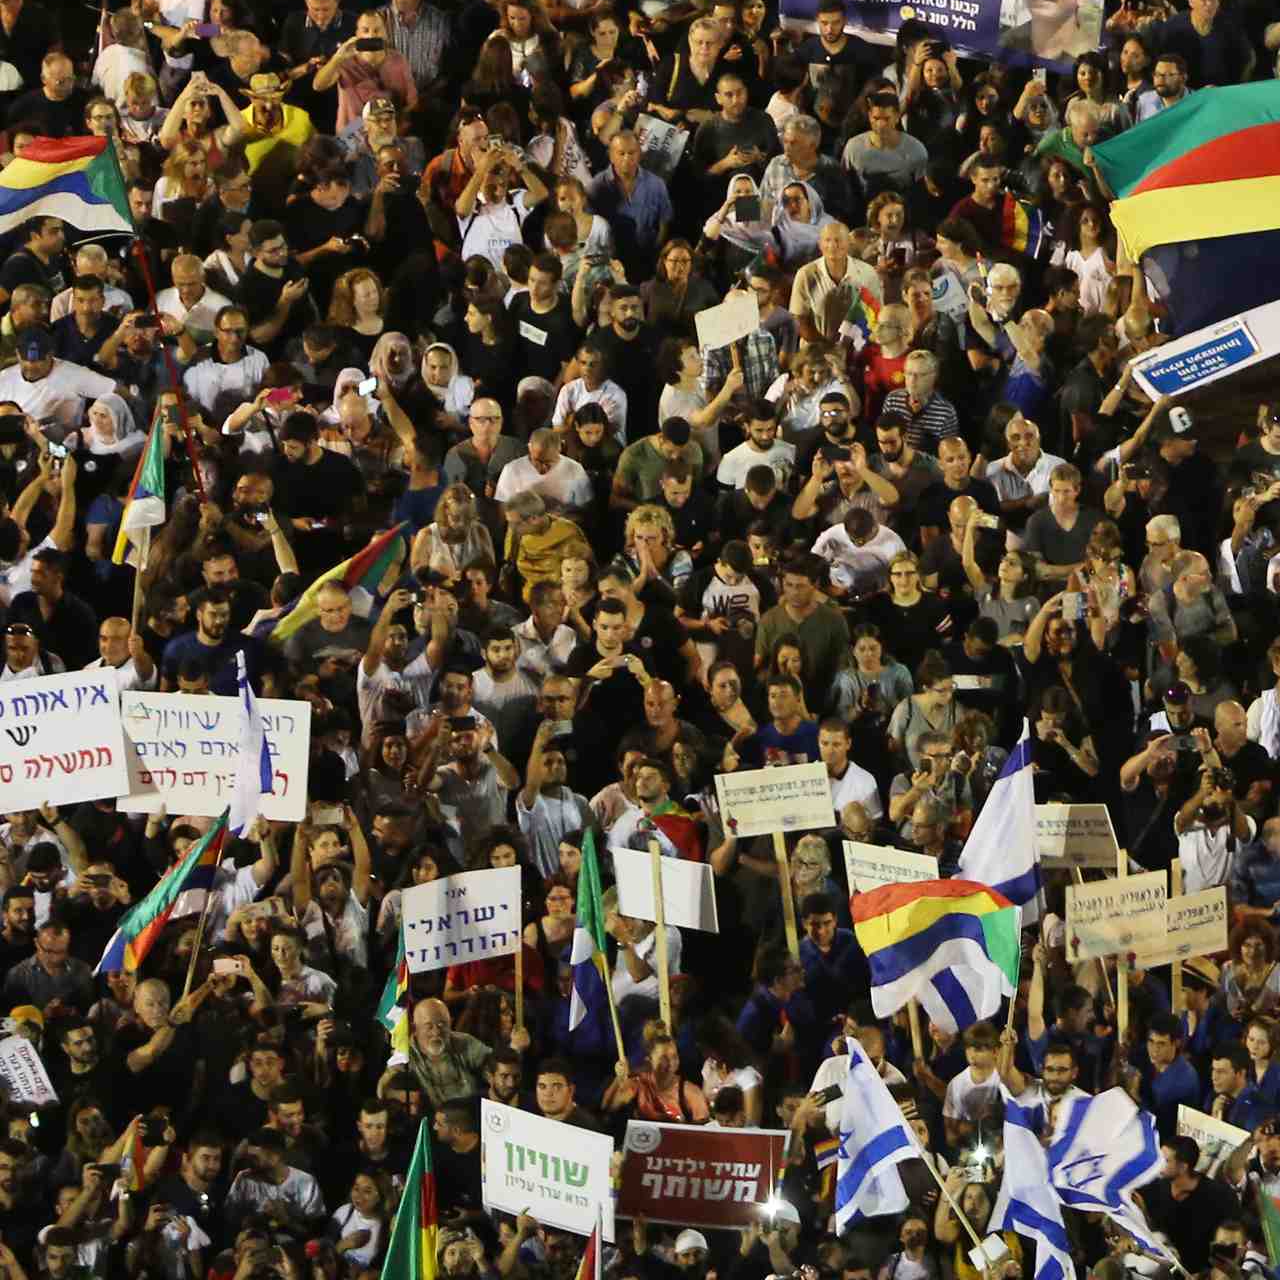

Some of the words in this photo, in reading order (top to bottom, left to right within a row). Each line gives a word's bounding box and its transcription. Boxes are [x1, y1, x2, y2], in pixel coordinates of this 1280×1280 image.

[950, 0, 980, 17] קבעו
[928, 11, 949, 26] סוג
[952, 15, 976, 30] חלל
[11, 689, 69, 717] אזרח
[74, 684, 110, 713] אין
[5, 725, 38, 747] יש
[133, 739, 188, 758] לאדם
[201, 741, 241, 756] אדם
[23, 747, 113, 779] ממשלה
[137, 769, 177, 788] לדם
[183, 771, 208, 787] דם
[445, 887, 467, 899] אני
[407, 903, 509, 935] ישראלי
[406, 929, 520, 963] יהודרוזי
[503, 1140, 590, 1188] שוויון
[645, 1155, 706, 1174] ילדינו
[711, 1160, 762, 1178] עתיד
[503, 1175, 534, 1192] עליון
[537, 1183, 562, 1201] ערך
[639, 1174, 758, 1203] משותף
[564, 1190, 589, 1208] הוא
